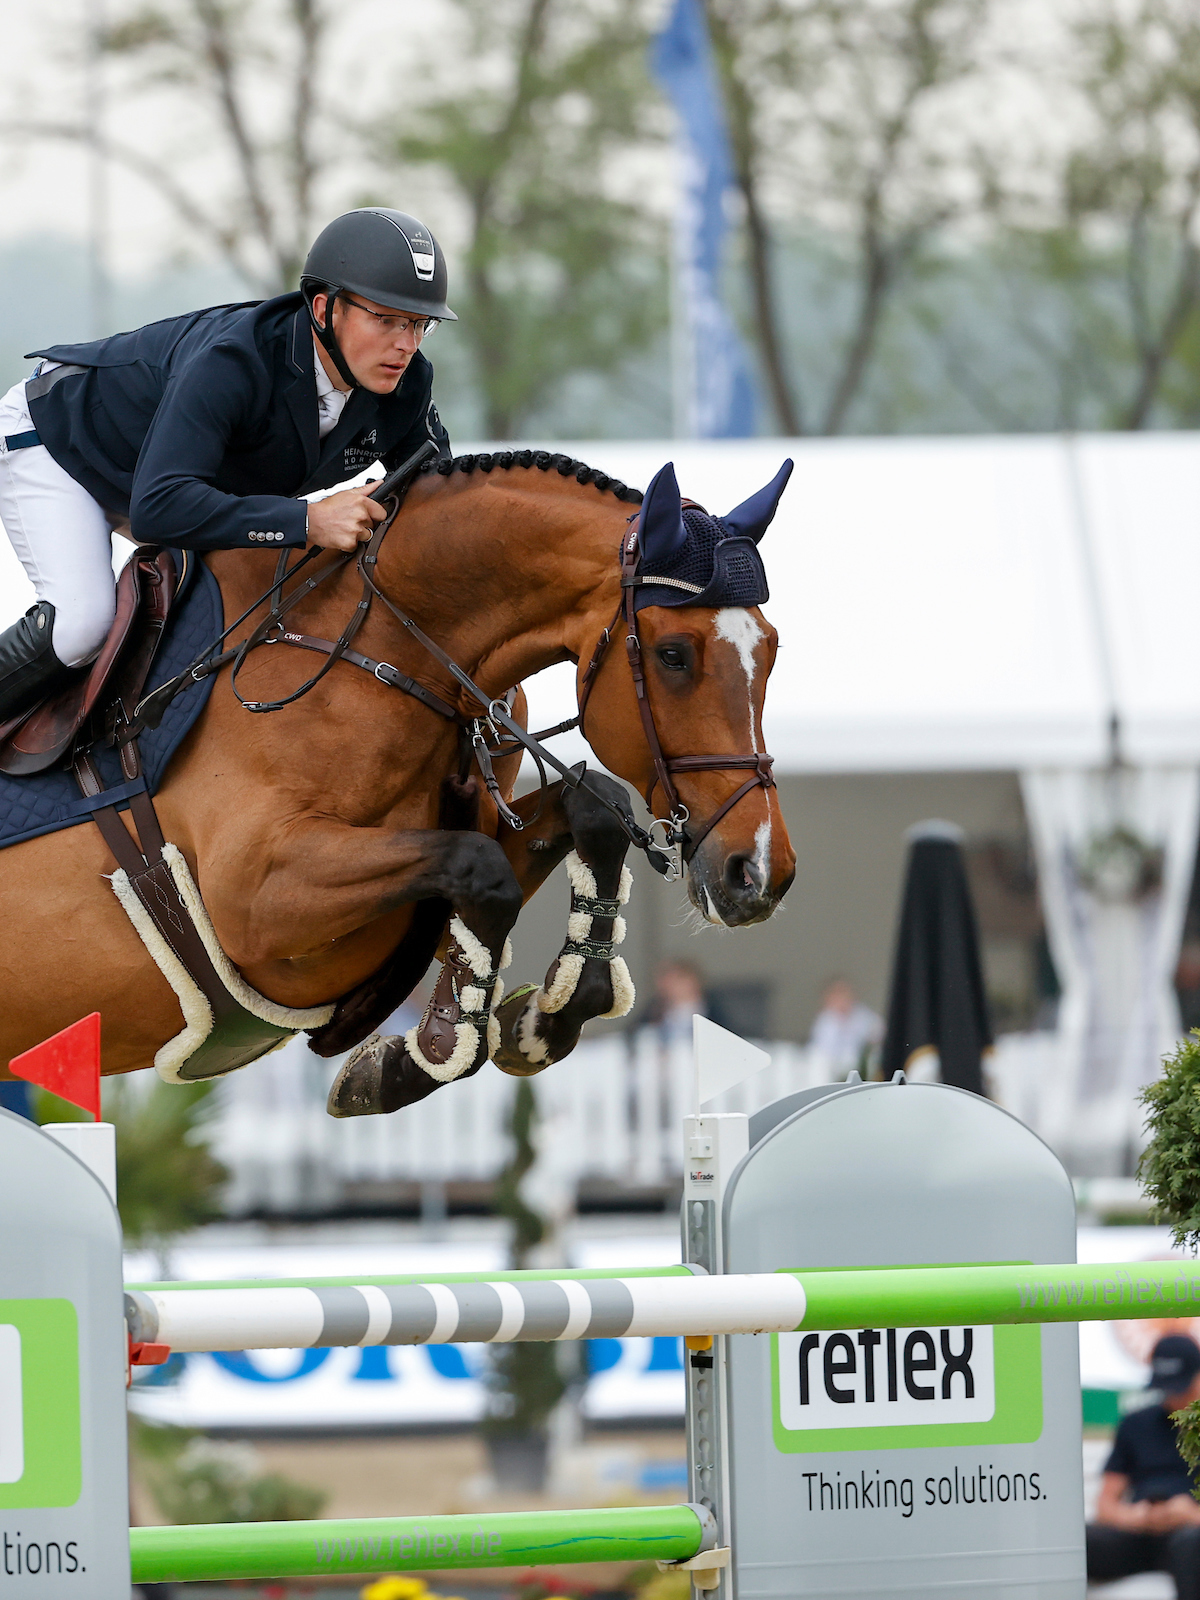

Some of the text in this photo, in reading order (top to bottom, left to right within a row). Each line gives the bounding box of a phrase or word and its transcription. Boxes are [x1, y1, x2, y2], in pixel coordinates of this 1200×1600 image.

[344, 448, 386, 458] HEINRICH
[627, 532, 638, 551] CWD
[284, 633, 302, 642] CWD
[690, 1171, 714, 1181] IsiTrade
[799, 1328, 975, 1406] reflex
[801, 1464, 1048, 1518] Thinking solutions.
[313, 1524, 502, 1563] www.reflex.de
